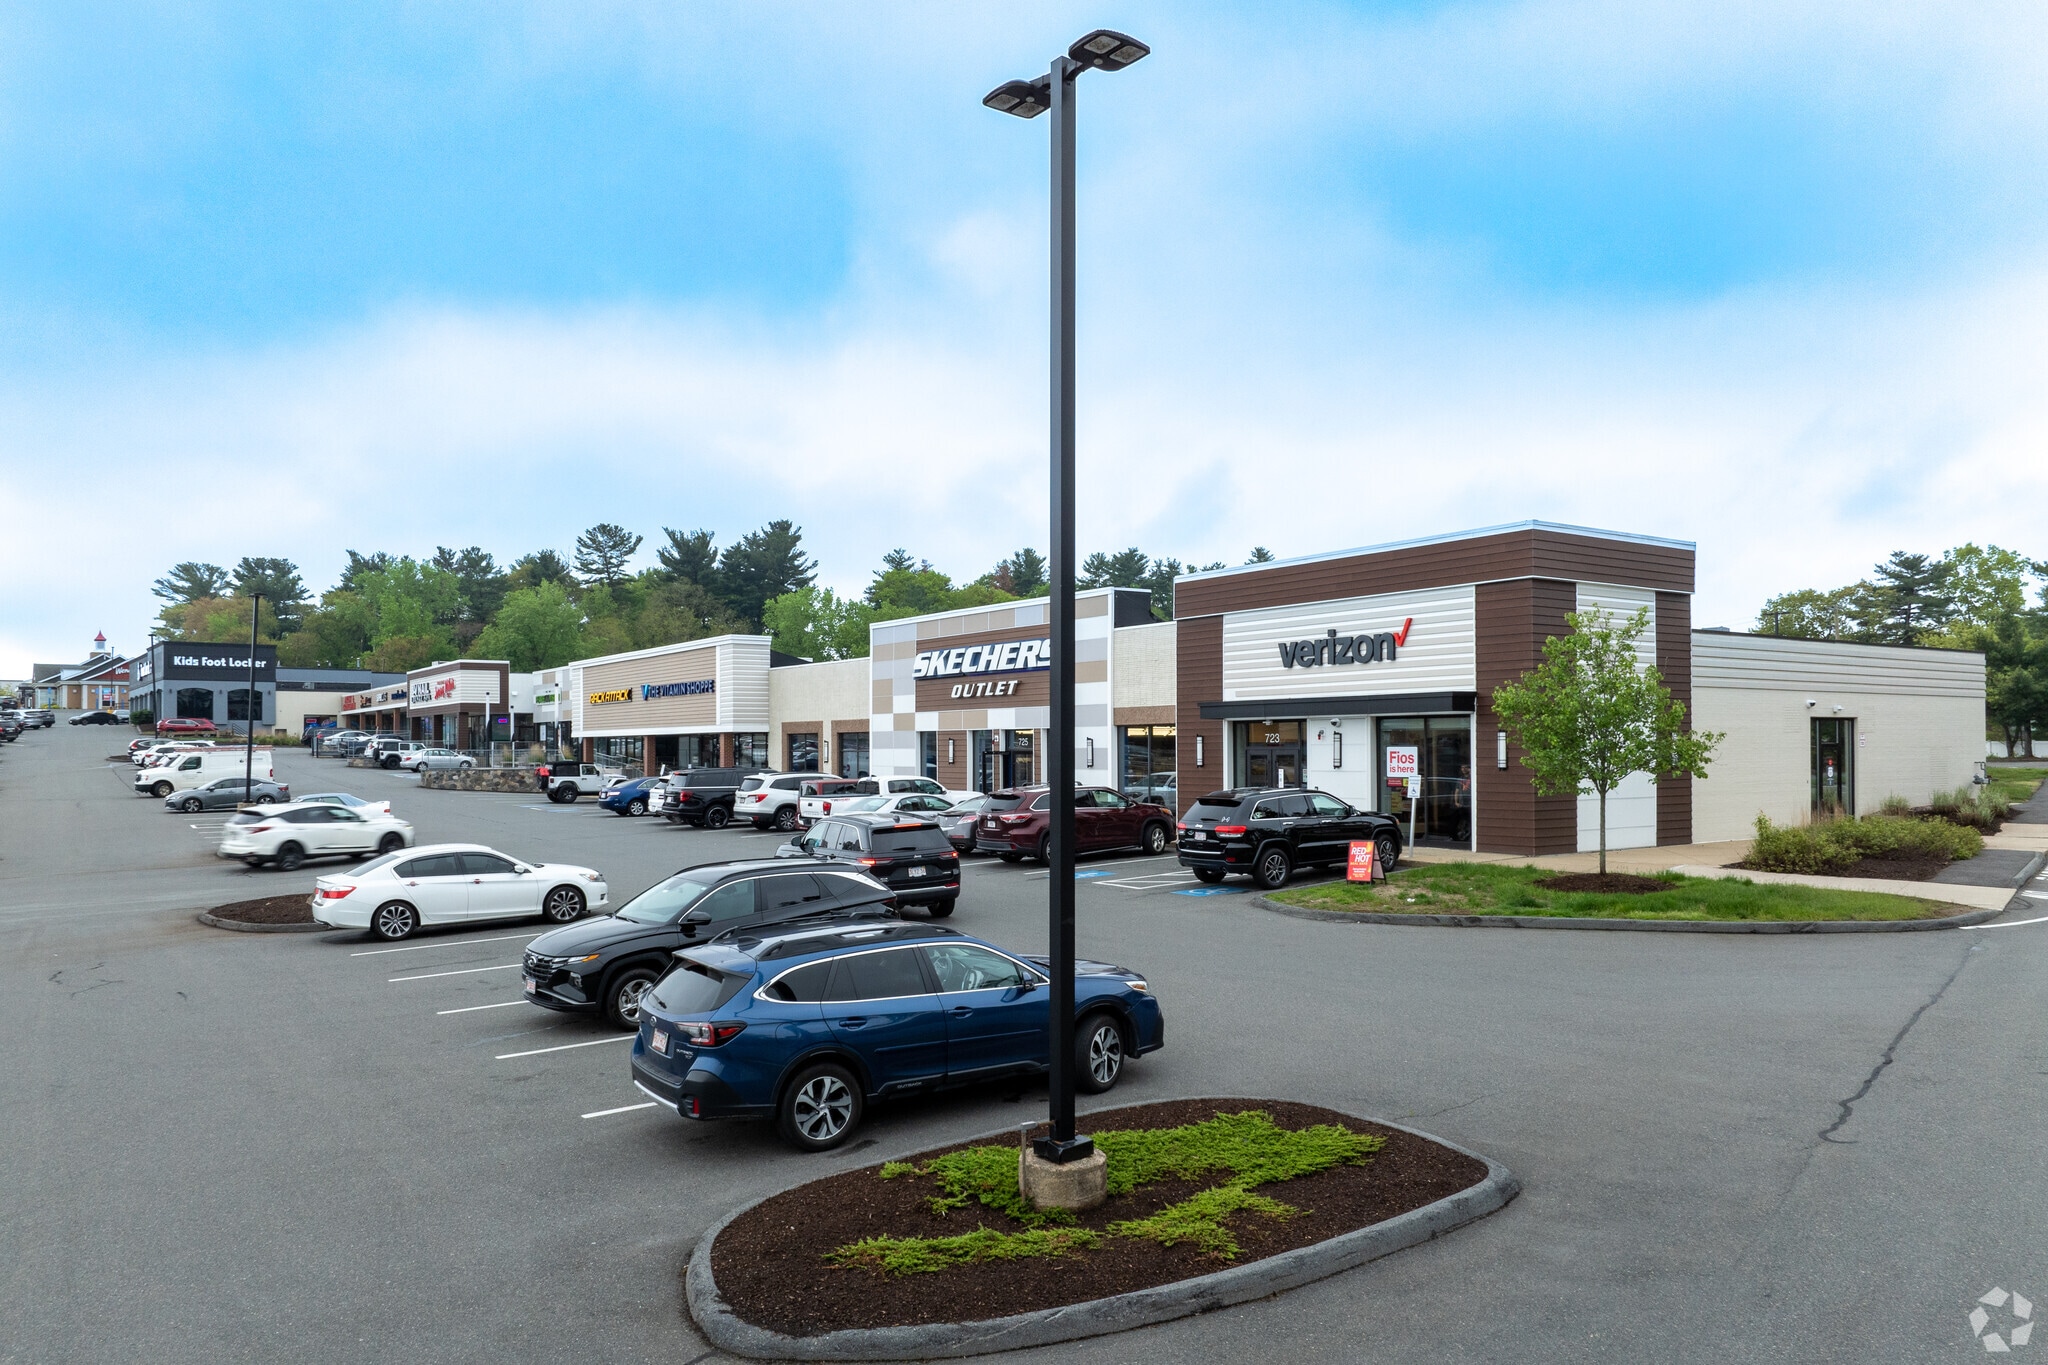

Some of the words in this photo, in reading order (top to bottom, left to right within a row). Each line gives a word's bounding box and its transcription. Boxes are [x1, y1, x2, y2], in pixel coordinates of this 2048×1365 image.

[1278, 629, 1396, 668] verizon
[173, 655, 199, 666] Kids
[202, 657, 226, 667] Foot
[912, 638, 1050, 679] SKECHERS
[650, 686, 661, 698] THE
[661, 683, 686, 697] VITAMIN
[686, 680, 715, 695] SHOPPE
[951, 680, 1019, 698] OUTLET
[605, 689, 629, 702] ATTACK
[1018, 737, 1029, 747] 725
[1265, 733, 1280, 744] 723
[1389, 751, 1415, 764] Fios
[1389, 764, 1396, 773] is
[1397, 765, 1415, 773] here
[1351, 847, 1367, 855] RED
[1355, 854, 1370, 862] HOT
